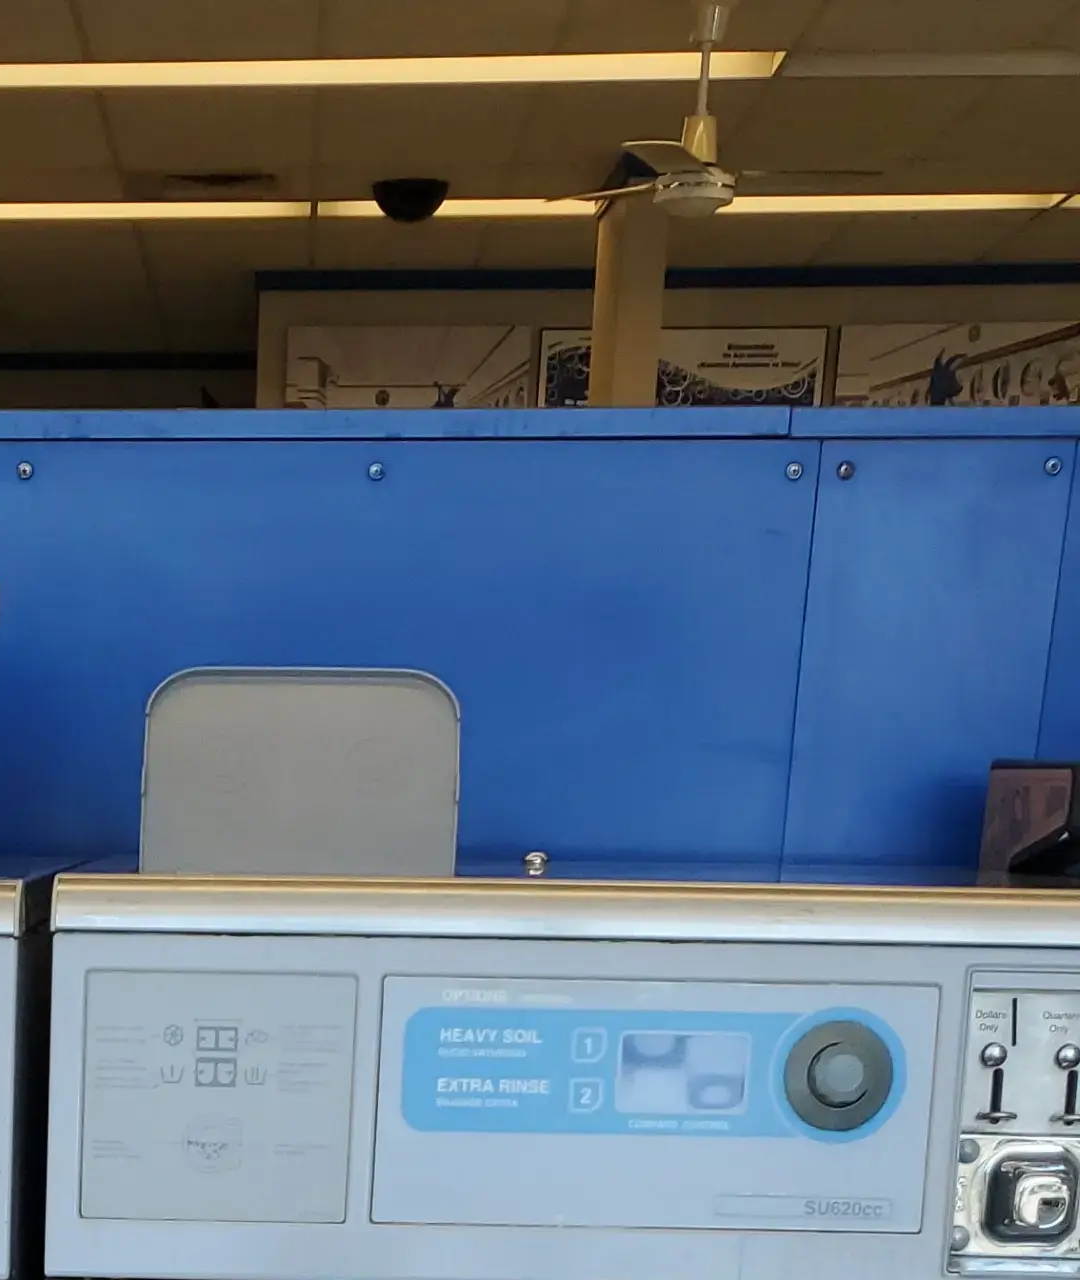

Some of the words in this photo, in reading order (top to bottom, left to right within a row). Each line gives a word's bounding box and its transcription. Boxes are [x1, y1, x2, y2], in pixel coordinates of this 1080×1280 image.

[442, 989, 507, 1002] OPTIONS
[975, 1010, 1007, 1019] Dollars
[440, 1027, 498, 1043] HEAVY
[502, 1029, 543, 1044] SOIL
[979, 1023, 998, 1032] Only
[1049, 1024, 1069, 1034] Only
[583, 1037, 593, 1055] 1
[436, 1077, 494, 1094] EXTRA
[498, 1079, 551, 1094] RINSE
[580, 1087, 592, 1105] 2
[803, 1200, 884, 1217] SU620cc
